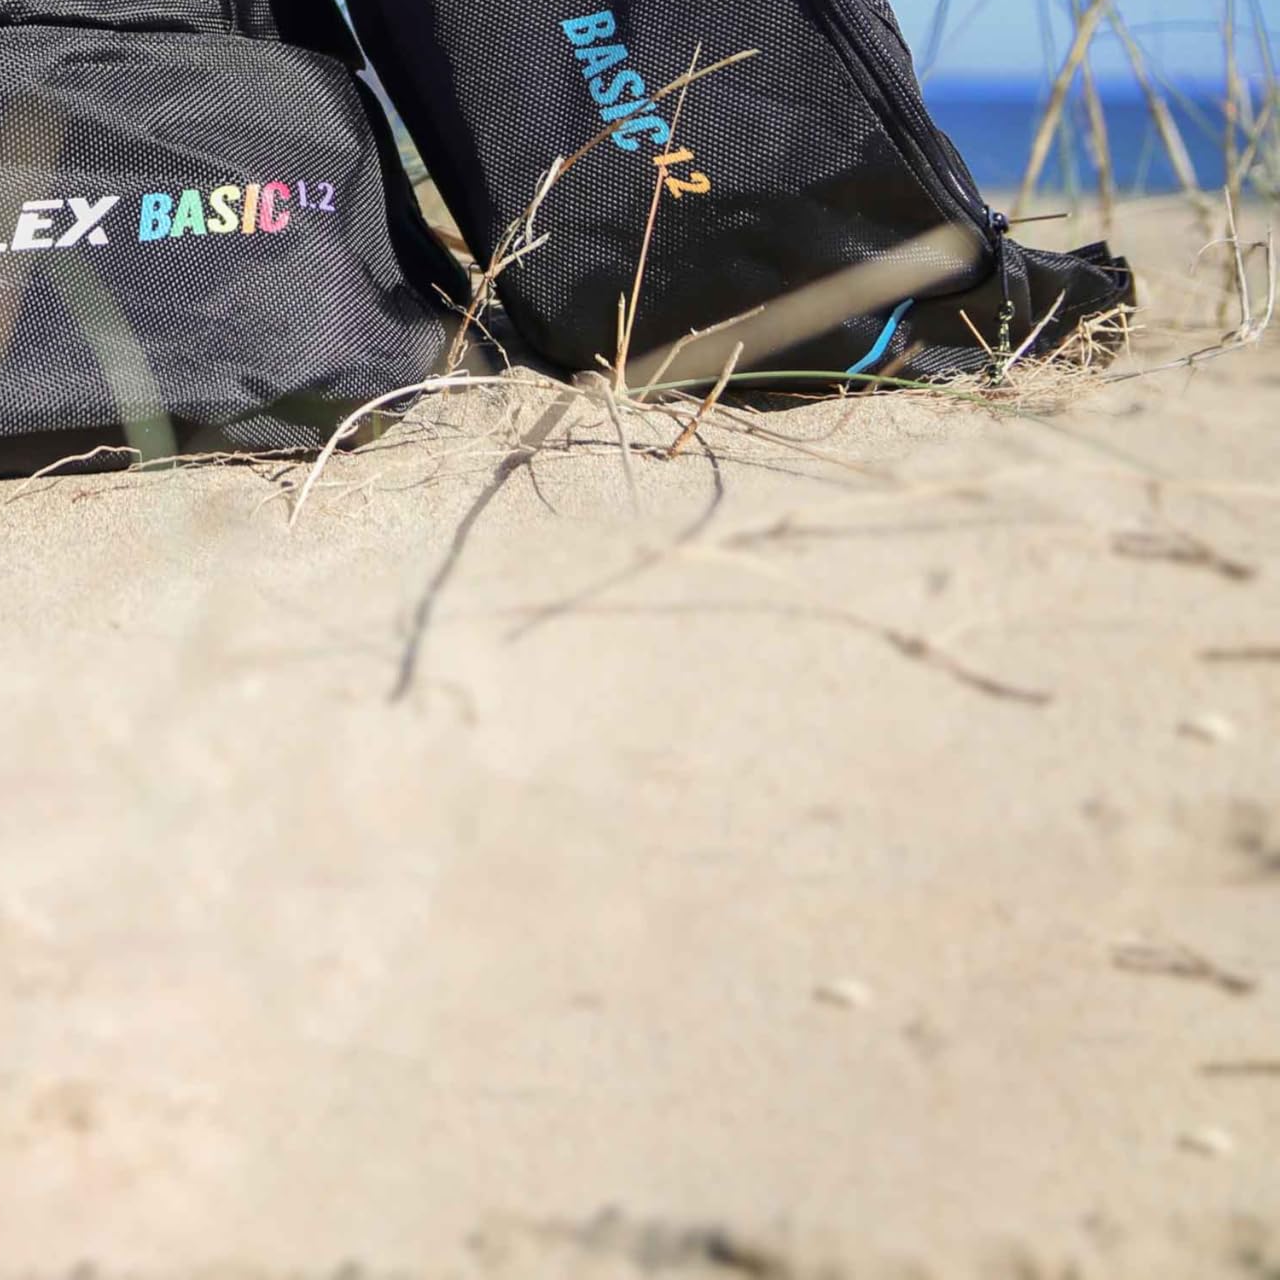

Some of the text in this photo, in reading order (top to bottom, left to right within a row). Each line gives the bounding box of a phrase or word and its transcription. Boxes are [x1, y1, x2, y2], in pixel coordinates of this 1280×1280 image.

[559, 10, 669, 151] BASIC
[138, 179, 291, 242] BASIC
[297, 179, 335, 211] 1.2
